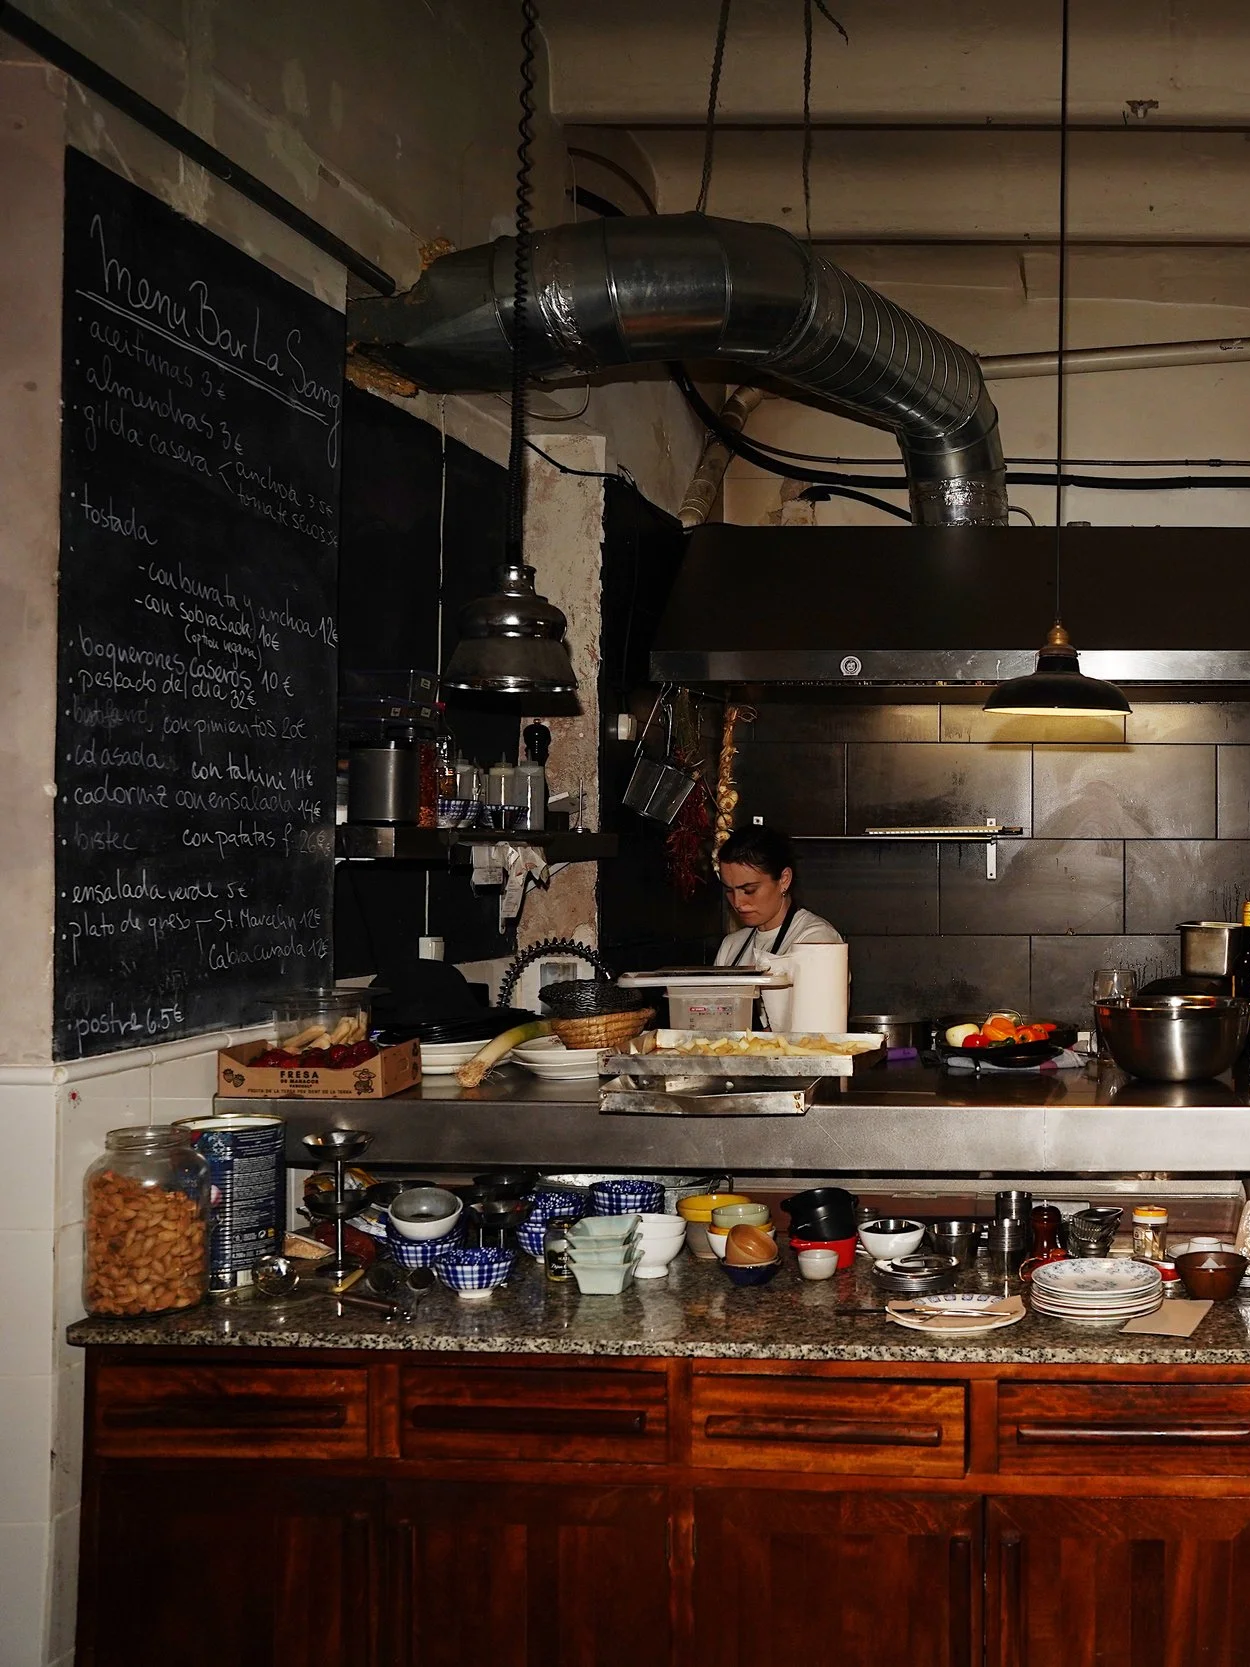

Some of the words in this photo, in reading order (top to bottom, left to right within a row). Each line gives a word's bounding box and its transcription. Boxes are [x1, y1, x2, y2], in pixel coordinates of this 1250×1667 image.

[89, 320, 194, 389] aceitunas
[90, 213, 191, 338] Menu
[189, 280, 248, 360] Bar
[253, 306, 284, 377] La
[286, 329, 341, 469] Sang
[86, 354, 214, 440] almendras
[83, 399, 144, 451] gilda
[149, 433, 213, 477] casera
[236, 461, 301, 507] anchoa
[237, 482, 288, 527] tomate
[80, 482, 158, 546] tostada
[178, 560, 240, 612] burata
[258, 598, 318, 638] anchoa
[180, 602, 251, 639] sobrasada
[258, 623, 280, 651] 10€
[79, 625, 185, 692] boquerones
[189, 656, 252, 691] caseros
[162, 673, 188, 699] del
[99, 742, 165, 770] asada
[162, 716, 191, 735] con
[193, 714, 277, 755] pimientos
[191, 761, 223, 780] con
[226, 752, 286, 791] tahini
[175, 791, 207, 812] con
[298, 799, 321, 823] 14€
[75, 820, 139, 850] bistec
[182, 828, 214, 848] con
[215, 820, 276, 859] patatas
[72, 868, 166, 904] ensalada
[168, 879, 219, 902] verde
[227, 881, 249, 899] 5€
[69, 910, 114, 966] plato
[120, 908, 142, 932] de
[148, 912, 191, 950] queso
[75, 1001, 143, 1053] postre
[146, 1003, 185, 1034] 6.5€
[280, 1070, 319, 1079] FRESA
